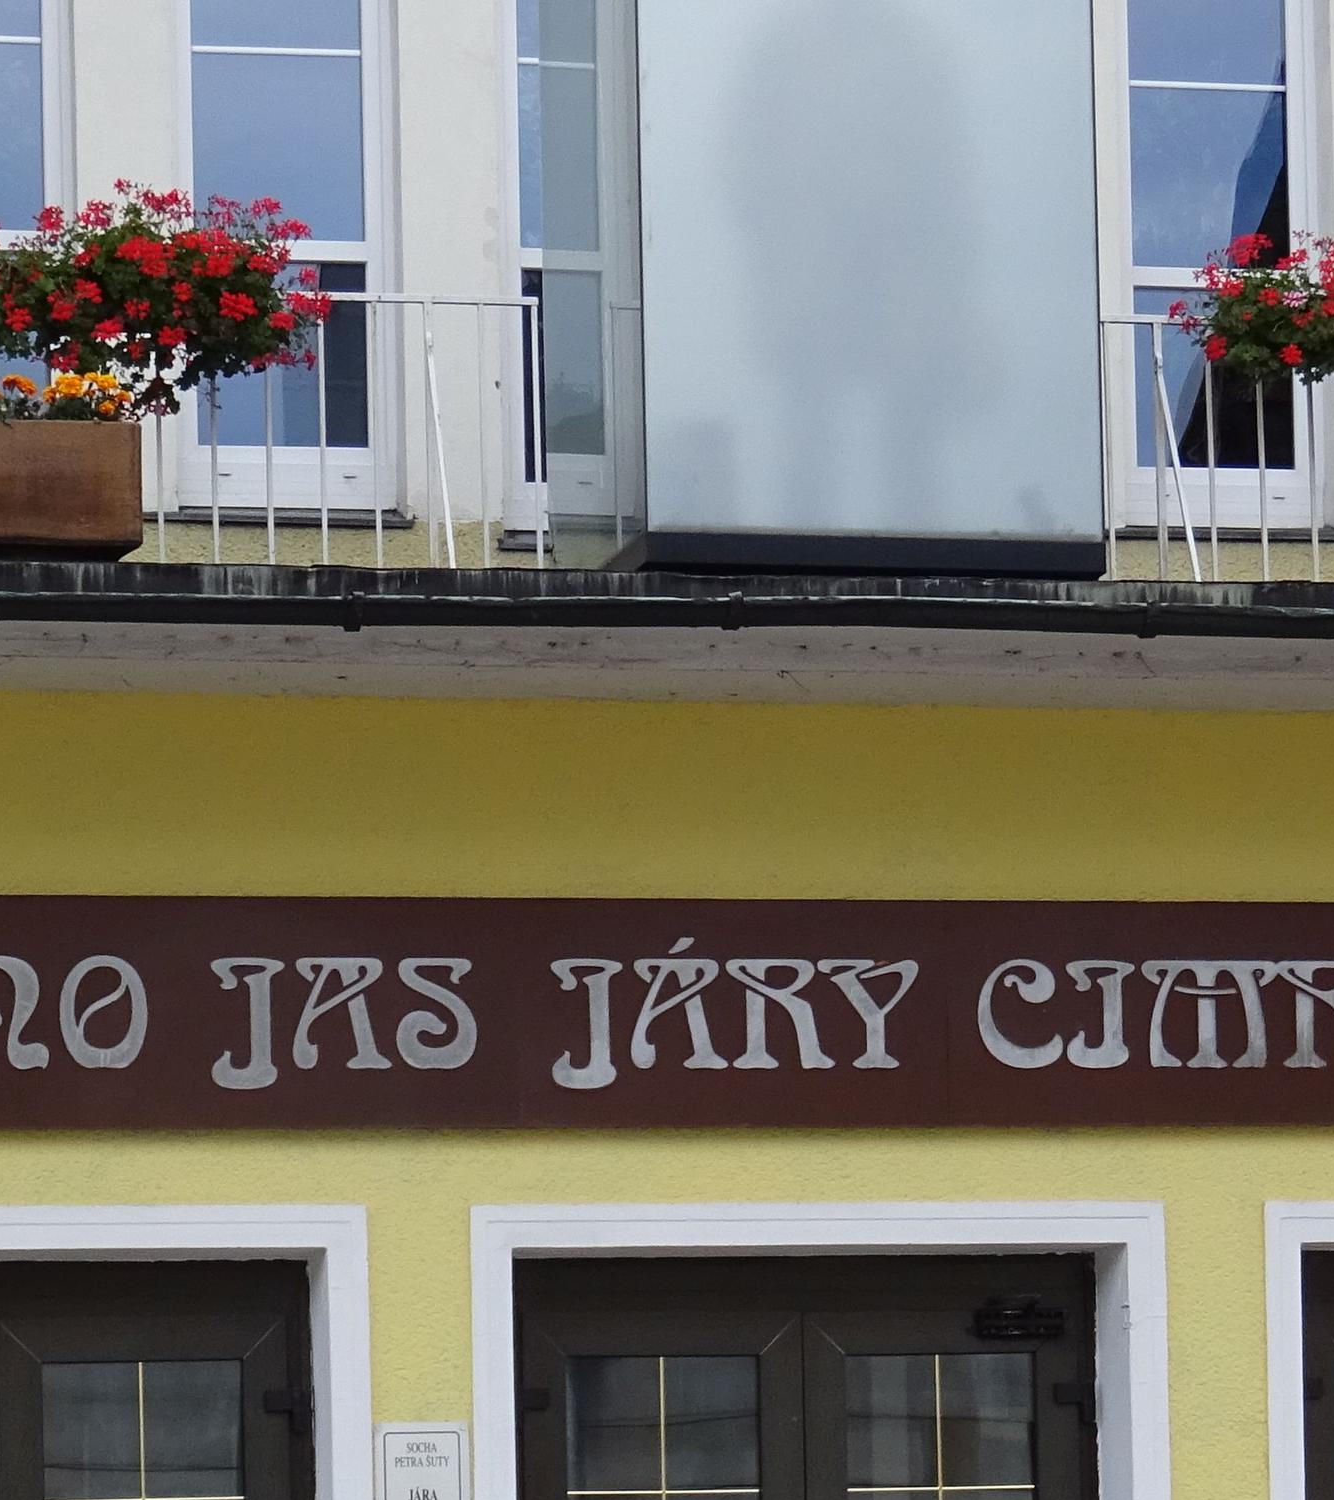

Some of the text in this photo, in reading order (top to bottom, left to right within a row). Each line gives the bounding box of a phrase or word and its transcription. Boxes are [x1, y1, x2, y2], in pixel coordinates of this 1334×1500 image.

[209, 957, 479, 1090] JAS
[550, 937, 920, 1091] JÁRY
[406, 1442, 437, 1454] SOCHA
[395, 1454, 450, 1468] PETRA ŠUTY
